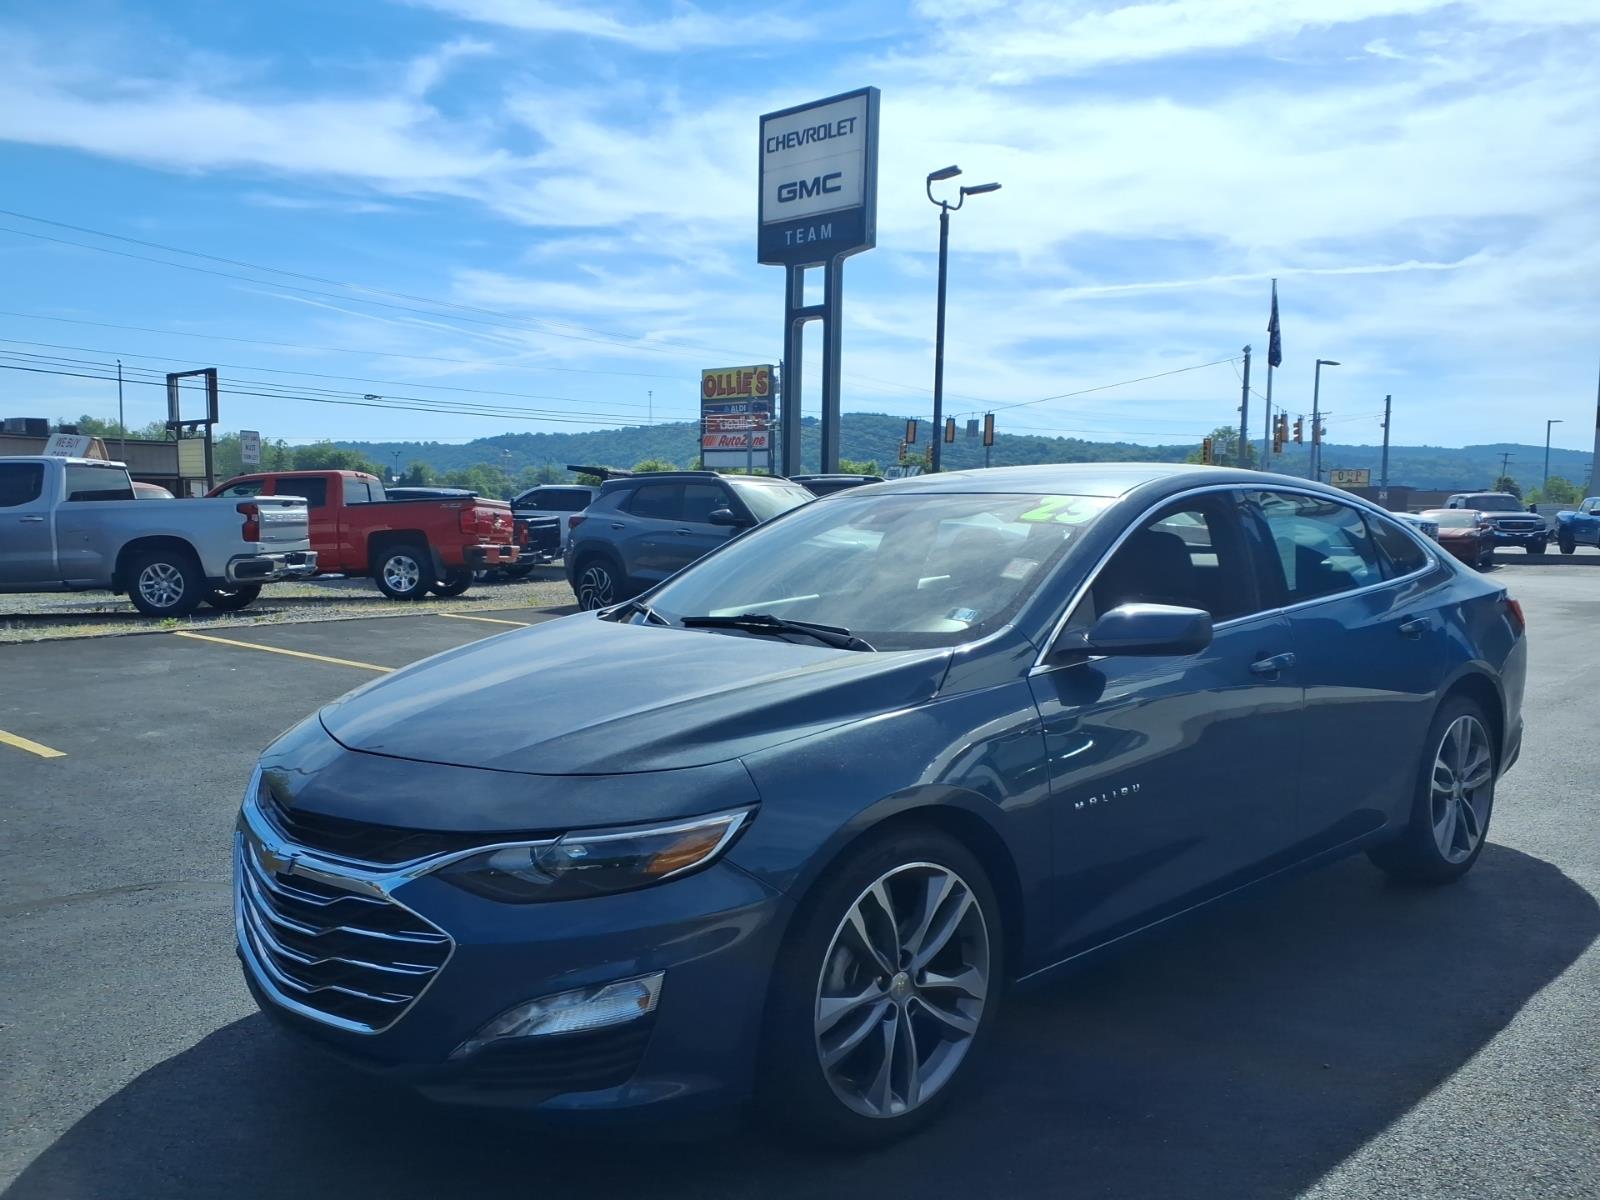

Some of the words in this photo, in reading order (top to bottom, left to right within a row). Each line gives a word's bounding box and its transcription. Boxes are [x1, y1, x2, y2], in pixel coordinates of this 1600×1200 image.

[766, 117, 857, 154] CHEVROLET
[778, 172, 842, 203] GMC
[785, 223, 832, 245] TEAM
[731, 405, 746, 413] ALDI
[719, 434, 766, 447] AutoZne
[1074, 783, 1140, 809] MALIBU
